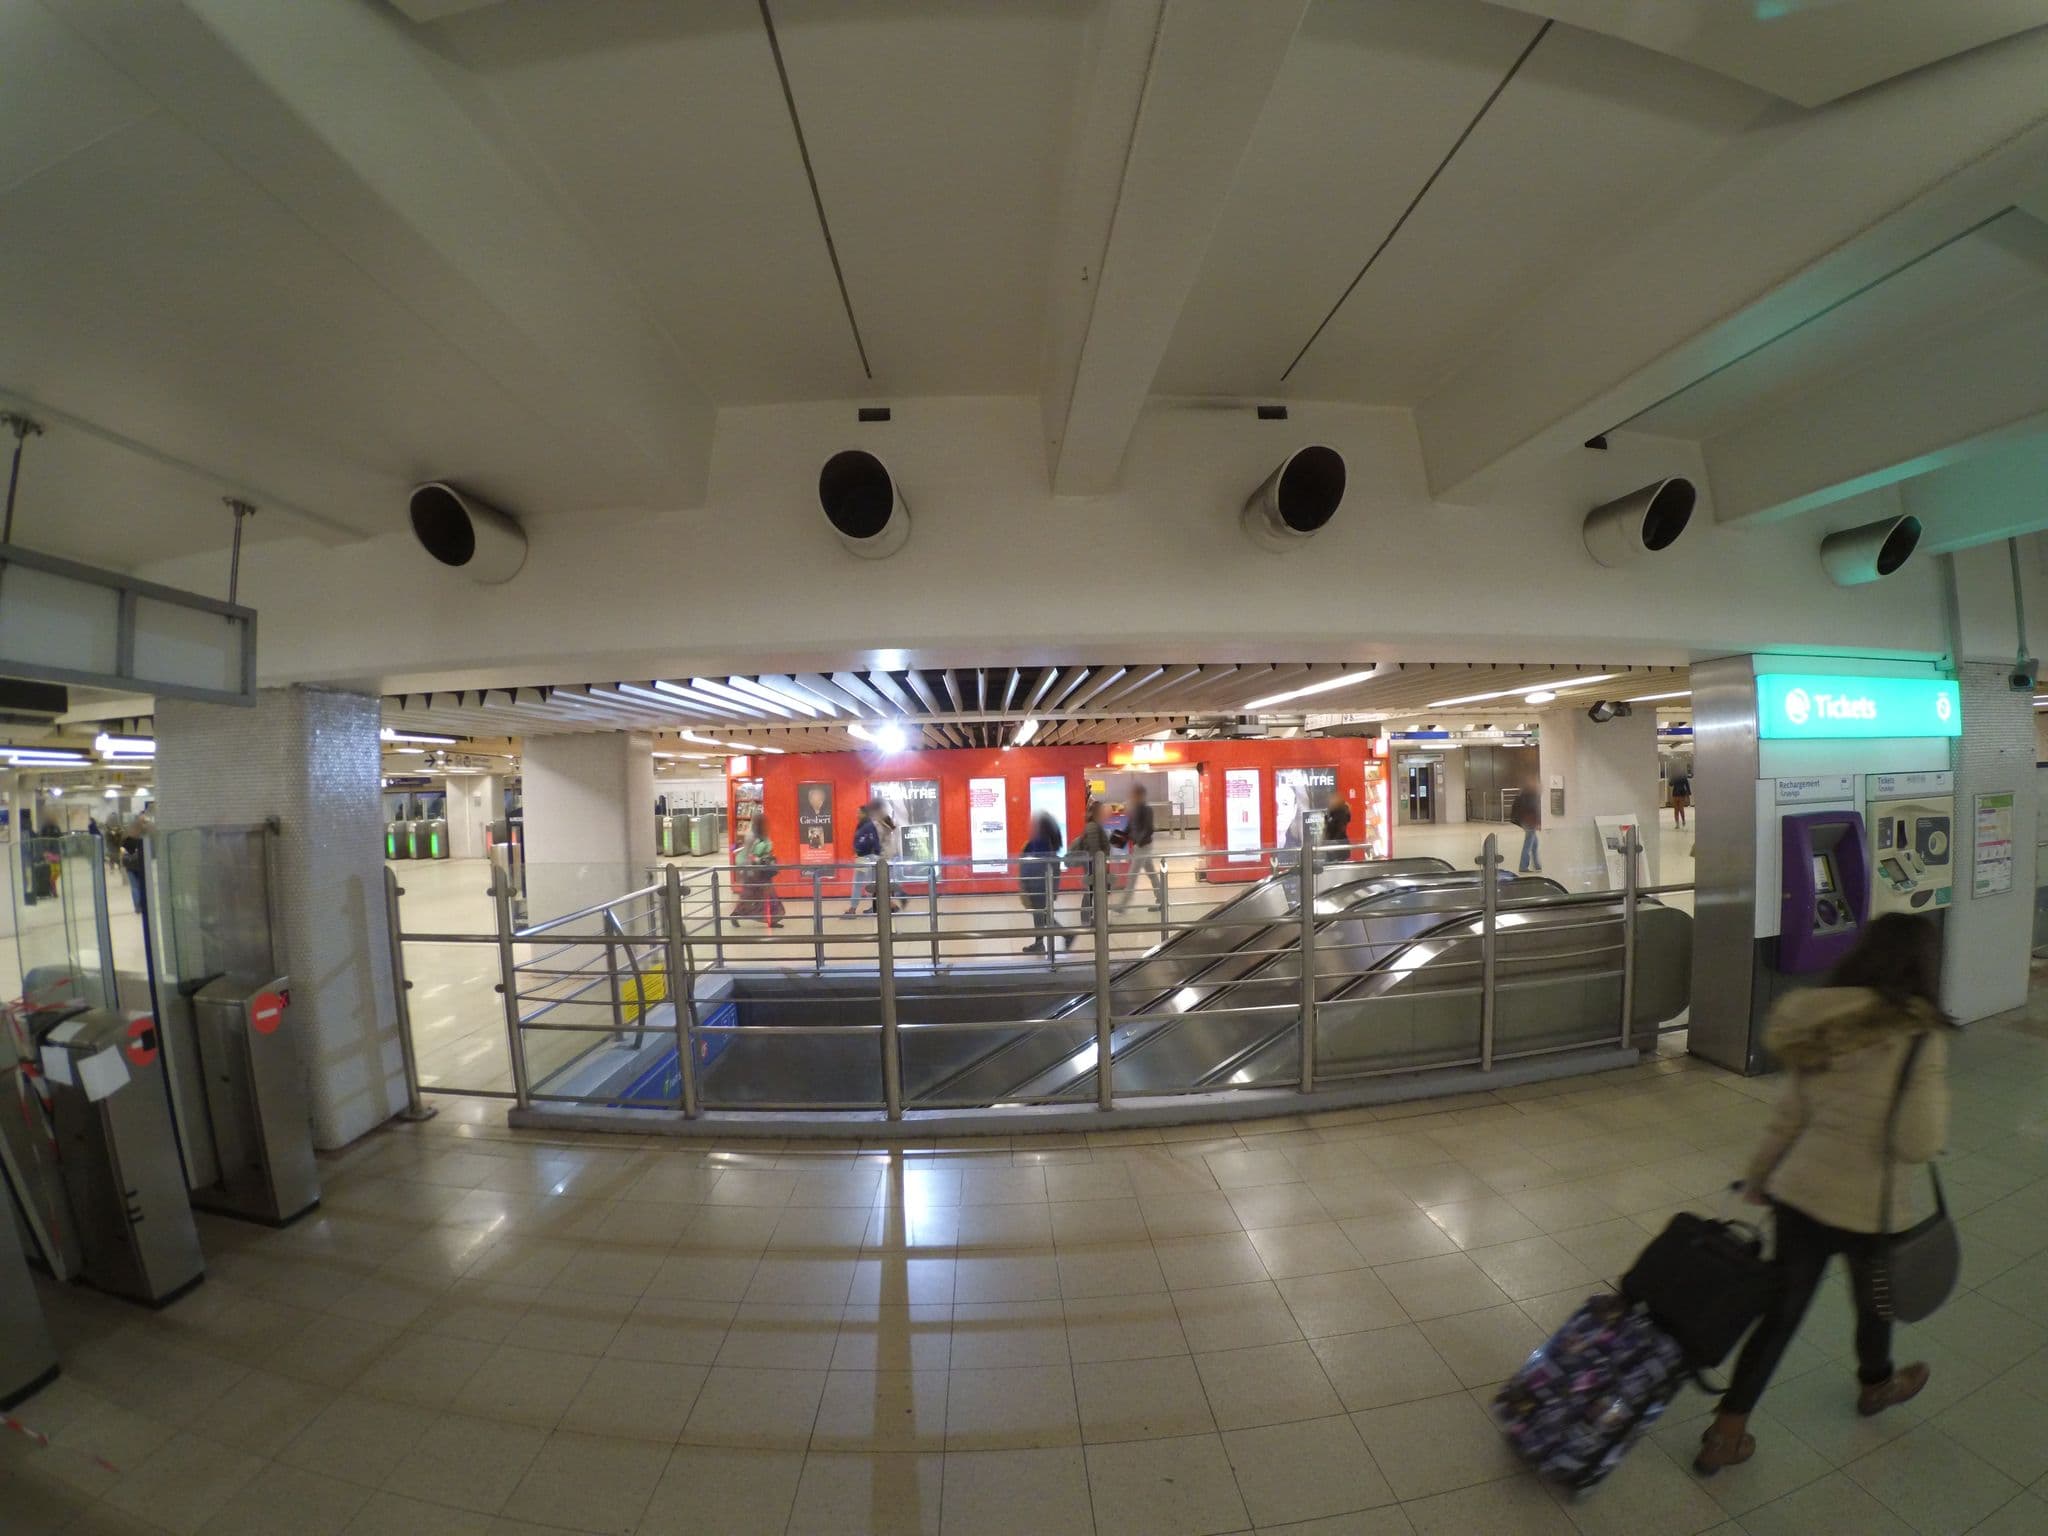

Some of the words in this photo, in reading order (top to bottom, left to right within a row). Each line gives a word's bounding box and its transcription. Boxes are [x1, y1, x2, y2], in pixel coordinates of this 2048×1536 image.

[1815, 693, 1877, 719] Tickets
[1279, 775, 1335, 787] LEAITRE
[1779, 779, 1820, 791] Rechargement
[799, 815, 831, 825] Giesbert
